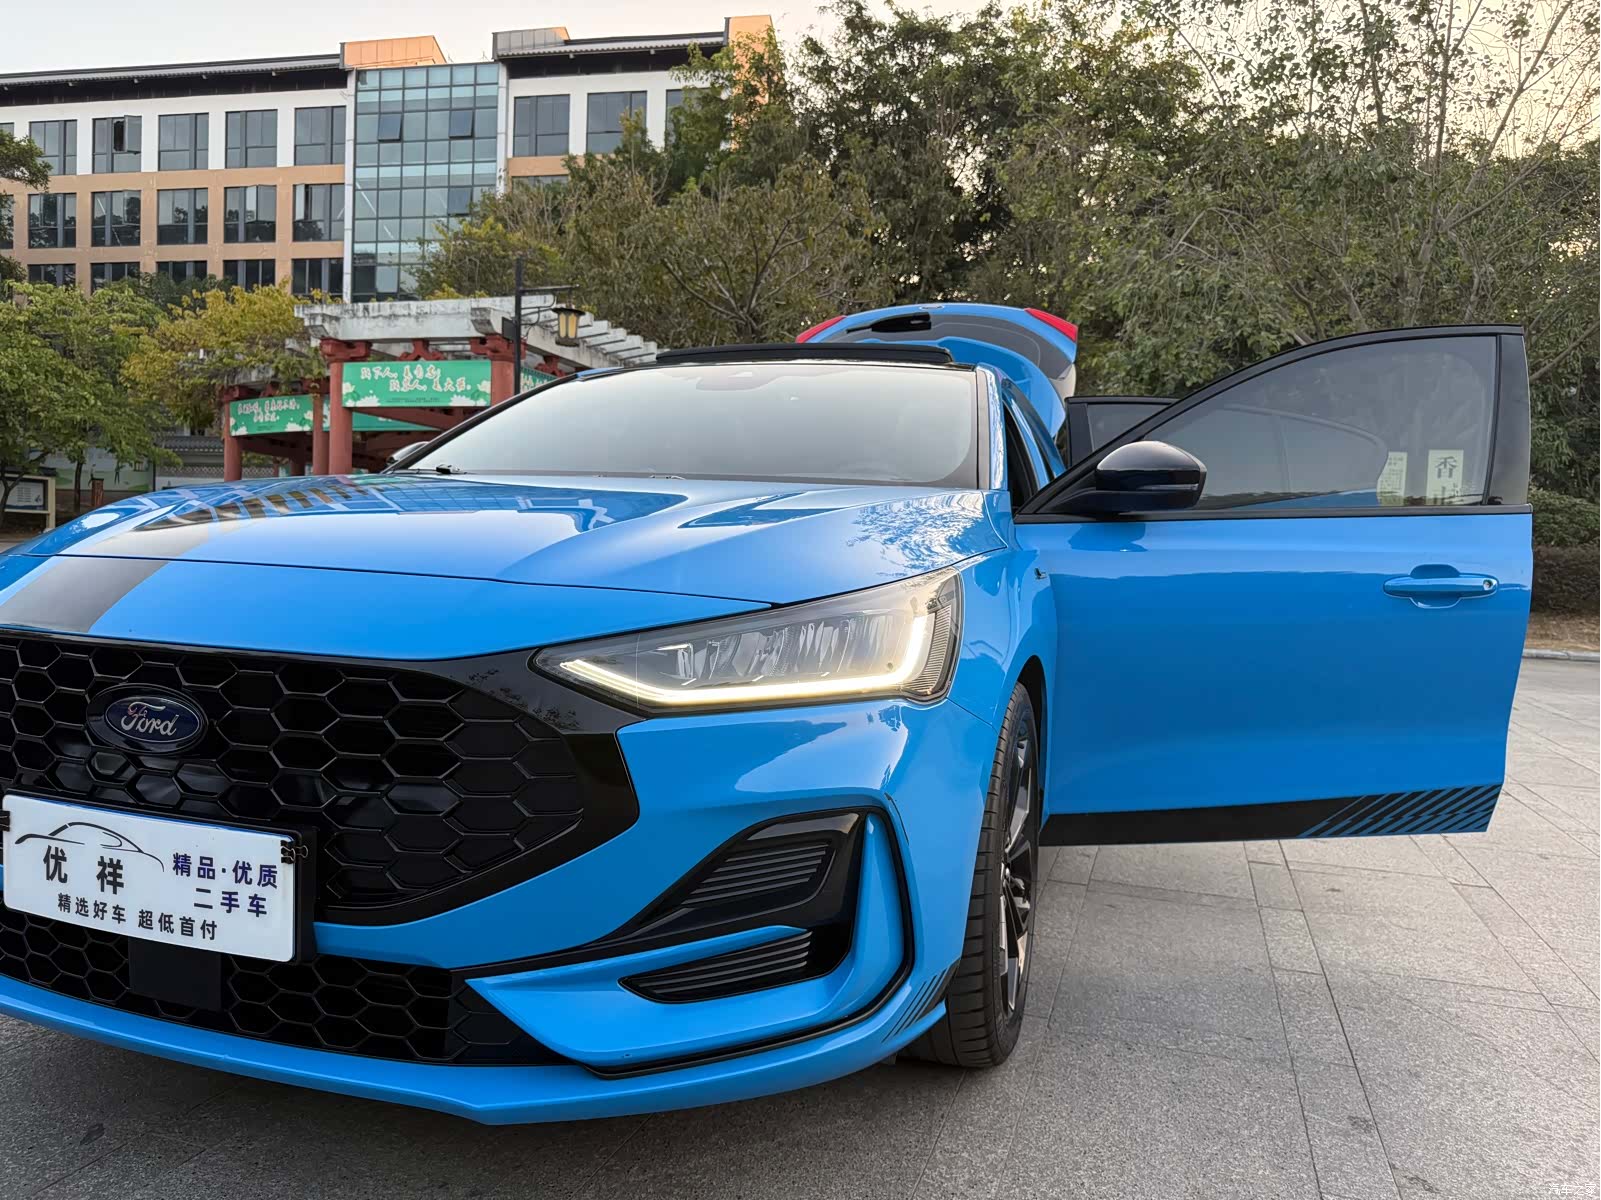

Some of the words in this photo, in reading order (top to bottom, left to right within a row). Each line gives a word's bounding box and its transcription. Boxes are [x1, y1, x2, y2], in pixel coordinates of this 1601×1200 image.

[120, 701, 180, 736] Ford
[57, 892, 127, 924] 精选好车
[138, 909, 218, 940] 超低首付
[193, 887, 268, 918] 二手车
